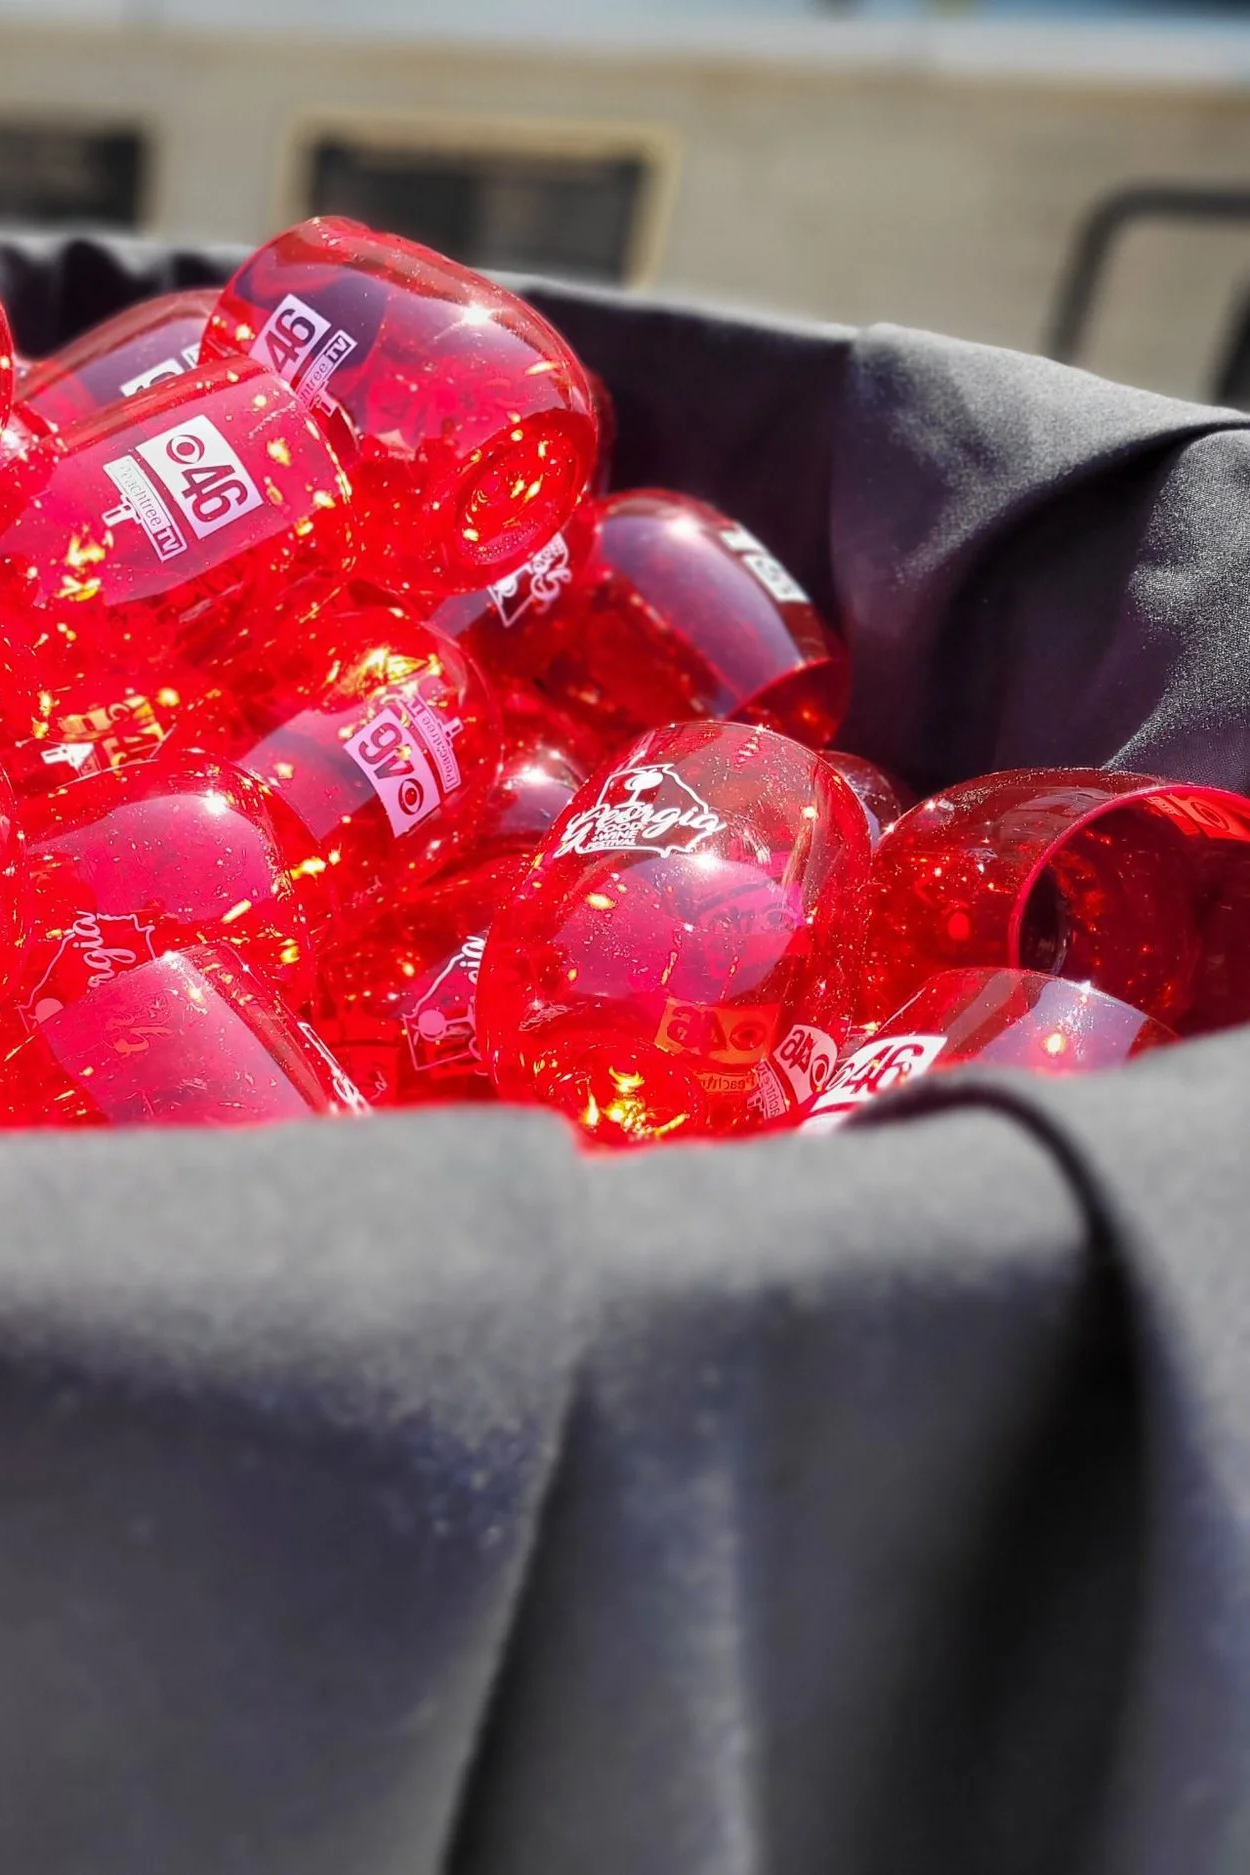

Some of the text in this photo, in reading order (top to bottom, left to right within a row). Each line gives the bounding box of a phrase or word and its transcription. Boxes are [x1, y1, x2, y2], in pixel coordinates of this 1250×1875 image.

[264, 307, 317, 375] 46
[325, 336, 348, 361] TV
[180, 464, 248, 523] 46
[157, 525, 181, 553] TV
[358, 722, 414, 780] 46
[553, 802, 728, 858] Georgia
[595, 821, 643, 835] FOOD
